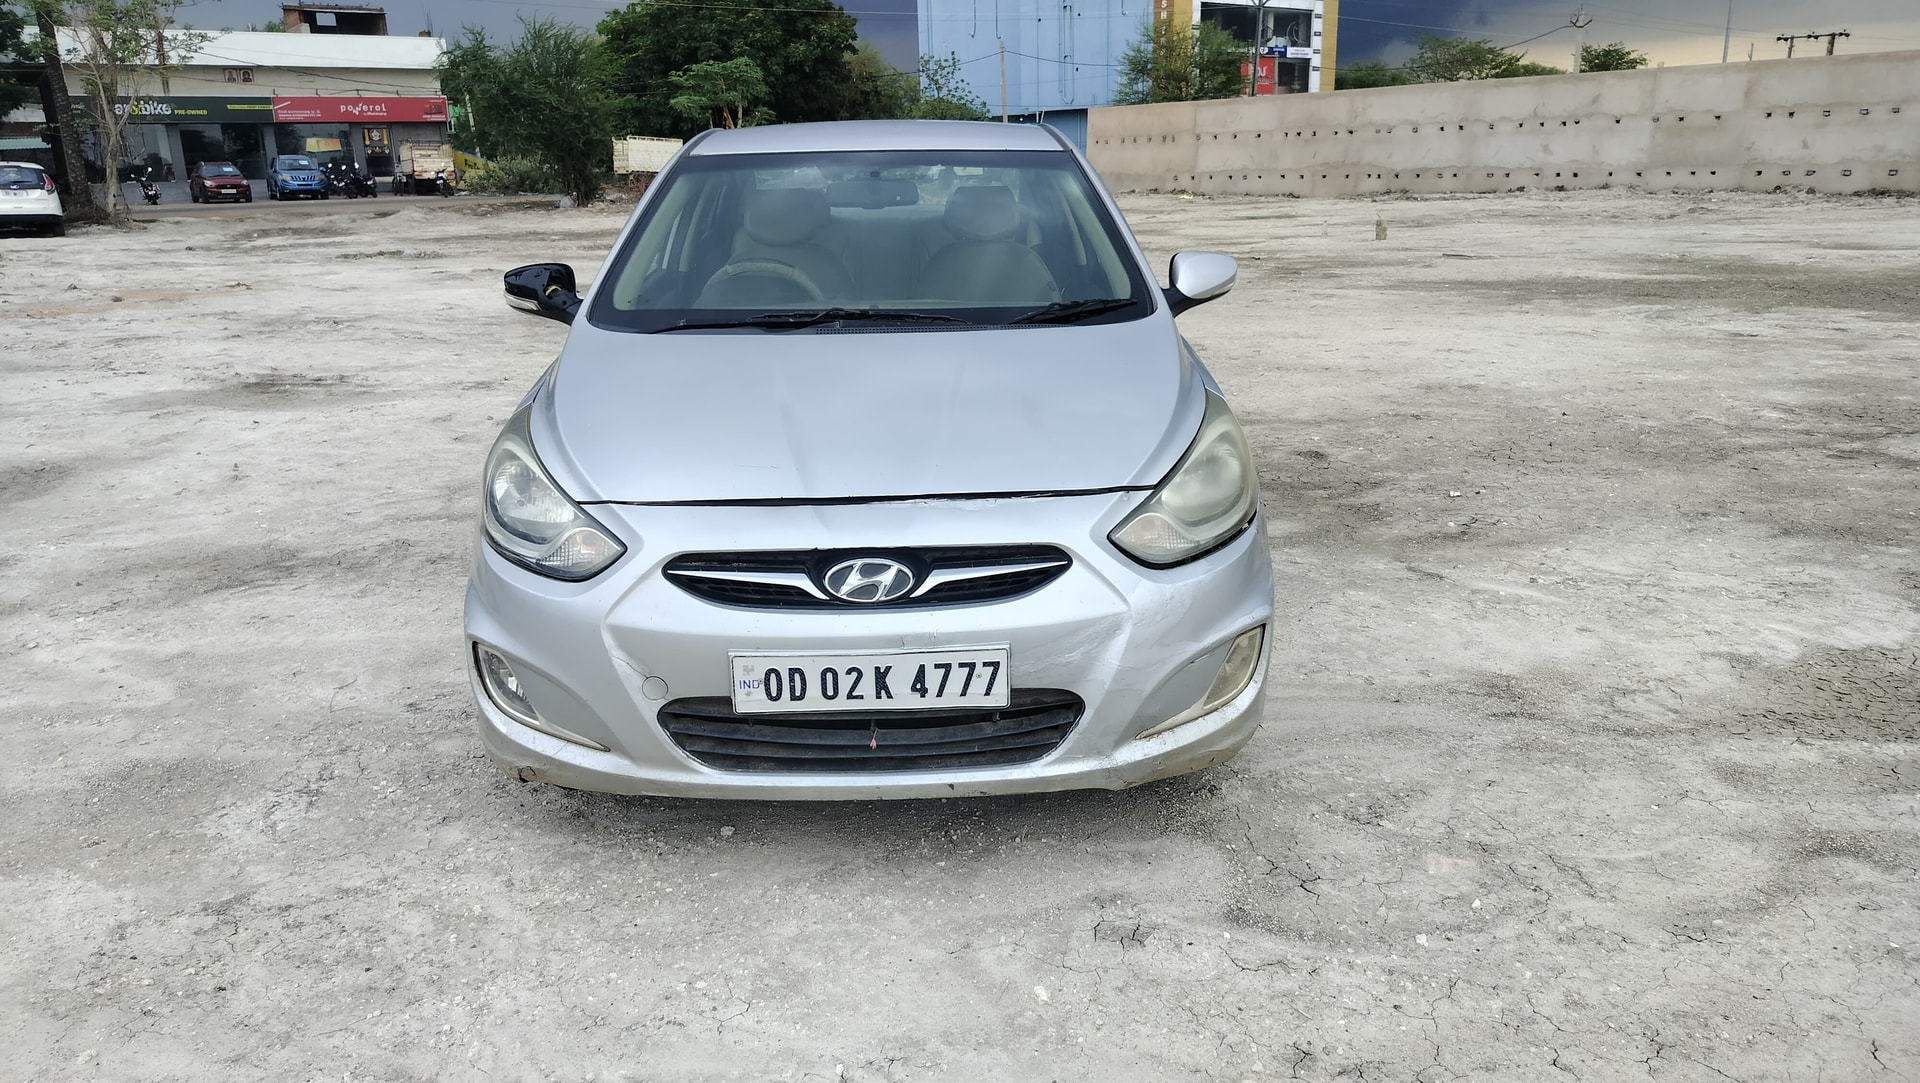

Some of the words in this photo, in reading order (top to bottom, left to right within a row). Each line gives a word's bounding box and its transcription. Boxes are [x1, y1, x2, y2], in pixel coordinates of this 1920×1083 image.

[739, 679, 759, 689] IND
[763, 667, 807, 702] OD
[820, 666, 864, 701] 02
[875, 665, 894, 700] K
[910, 661, 1001, 698] 4777
